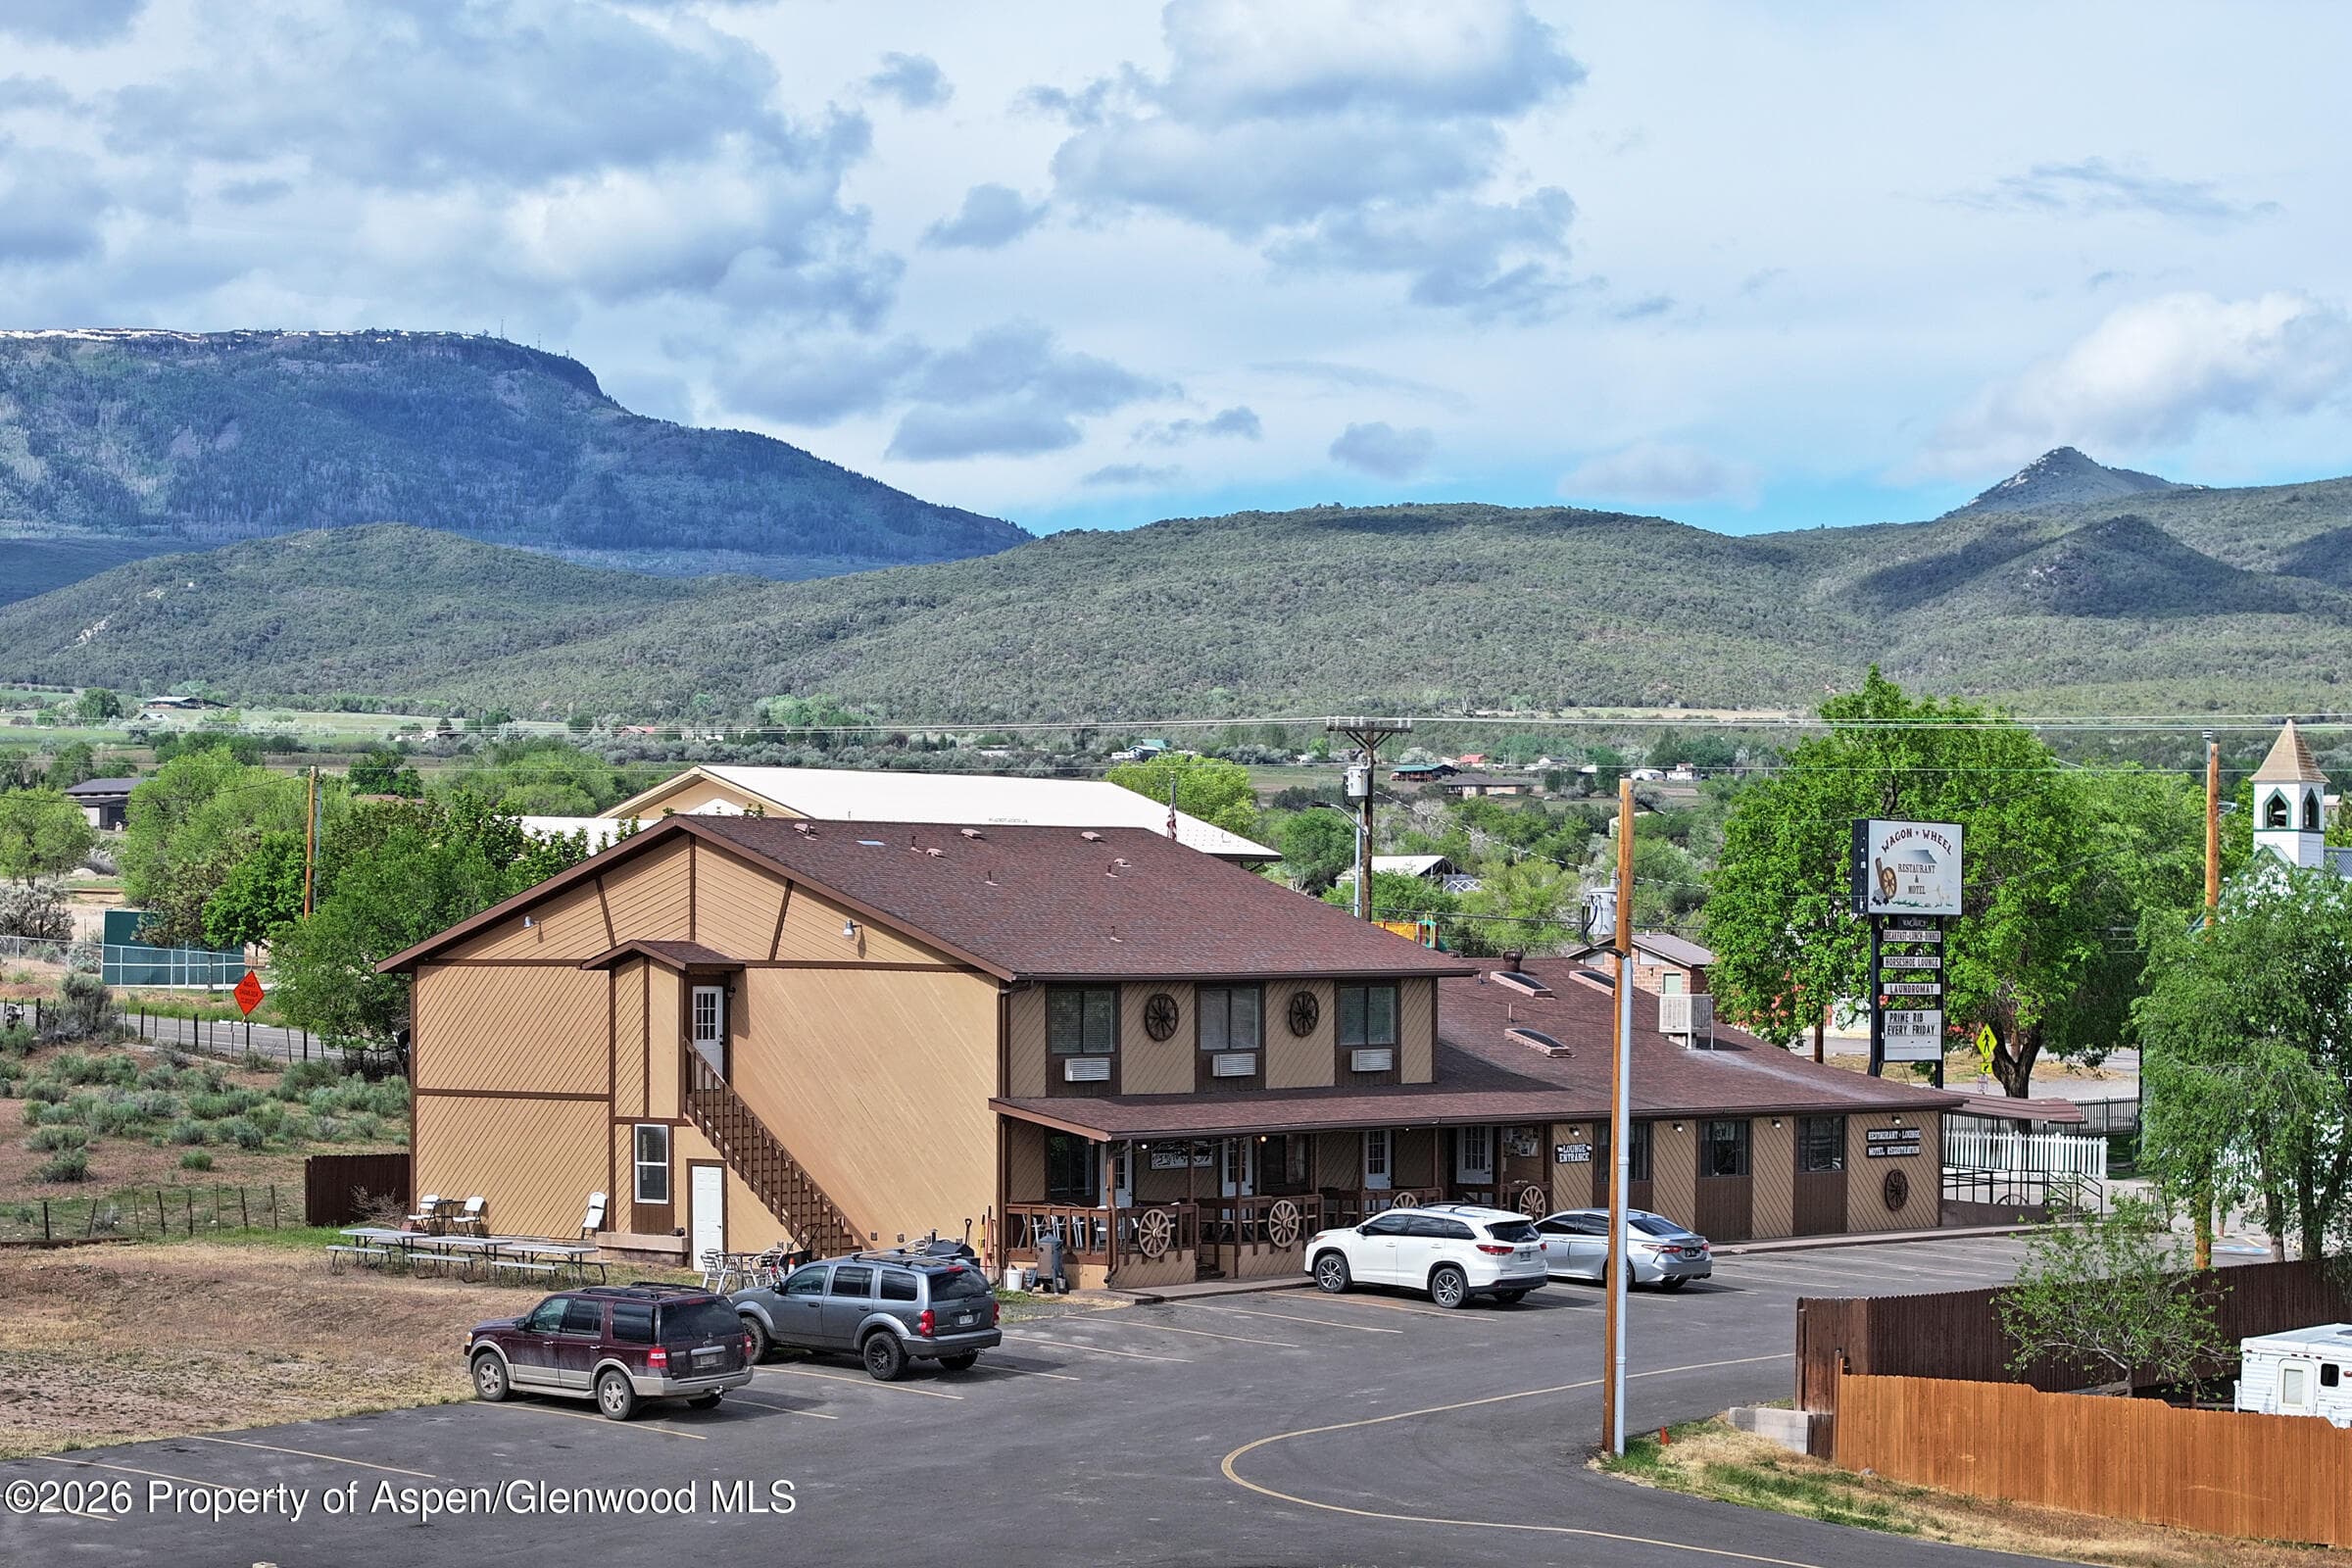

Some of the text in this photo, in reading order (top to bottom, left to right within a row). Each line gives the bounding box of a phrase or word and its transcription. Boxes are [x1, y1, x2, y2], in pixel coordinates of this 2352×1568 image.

[1882, 828, 1952, 856] WAGON WHEEL
[1897, 863, 1936, 874] RESTAURANT
[1914, 874, 1920, 883] &
[1907, 885, 1926, 895] MOTEL
[1885, 956, 1938, 967] HORSESHOE LOUNGE
[1889, 984, 1934, 995] LAUNDROMAT
[1889, 1012, 1924, 1023] PRIME RIB
[1887, 1024, 1936, 1036] EVERY FRIDAY
[1562, 1144, 1587, 1153] LOUNGE
[1868, 1147, 1886, 1156] MOTEL
[1559, 1152, 1590, 1162] ENTRANCE
